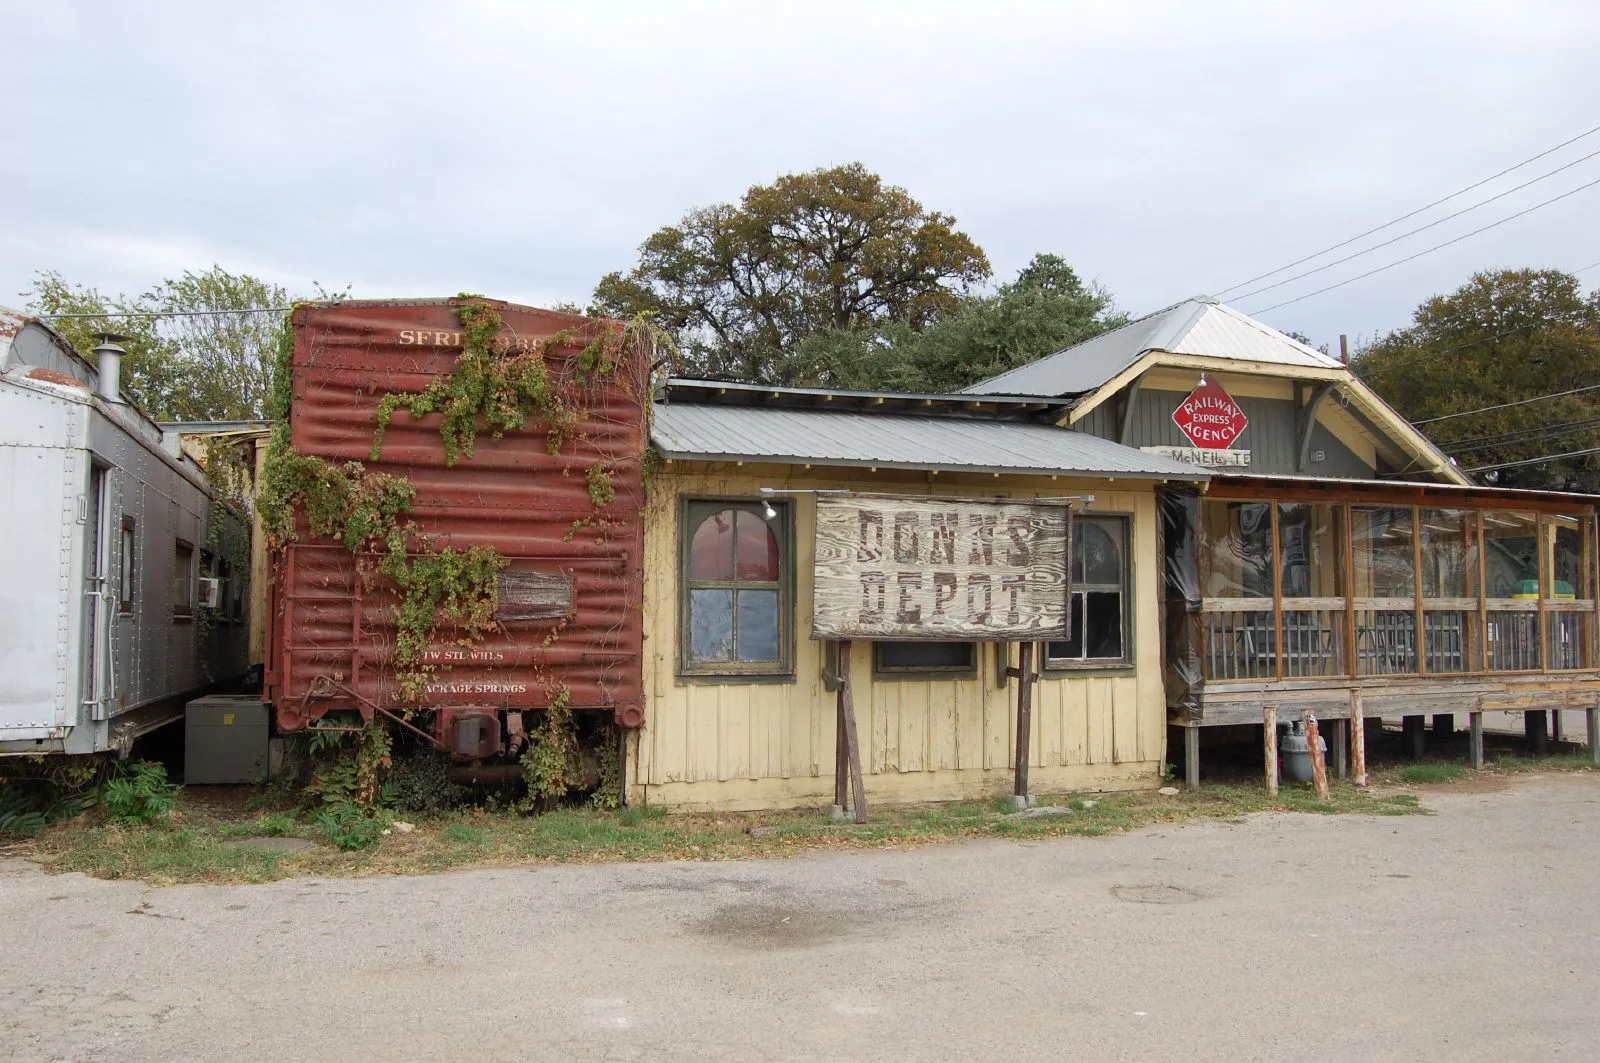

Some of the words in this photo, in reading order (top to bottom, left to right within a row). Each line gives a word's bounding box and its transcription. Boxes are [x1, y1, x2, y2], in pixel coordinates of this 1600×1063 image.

[1183, 397, 1240, 418] RAILWAY
[1193, 413, 1230, 425] EXPRESS
[1183, 421, 1236, 441] AGENCY
[858, 571, 1026, 625] DEPOT
[424, 684, 473, 693] ACKAGE
[474, 684, 527, 693] SPRINGS
